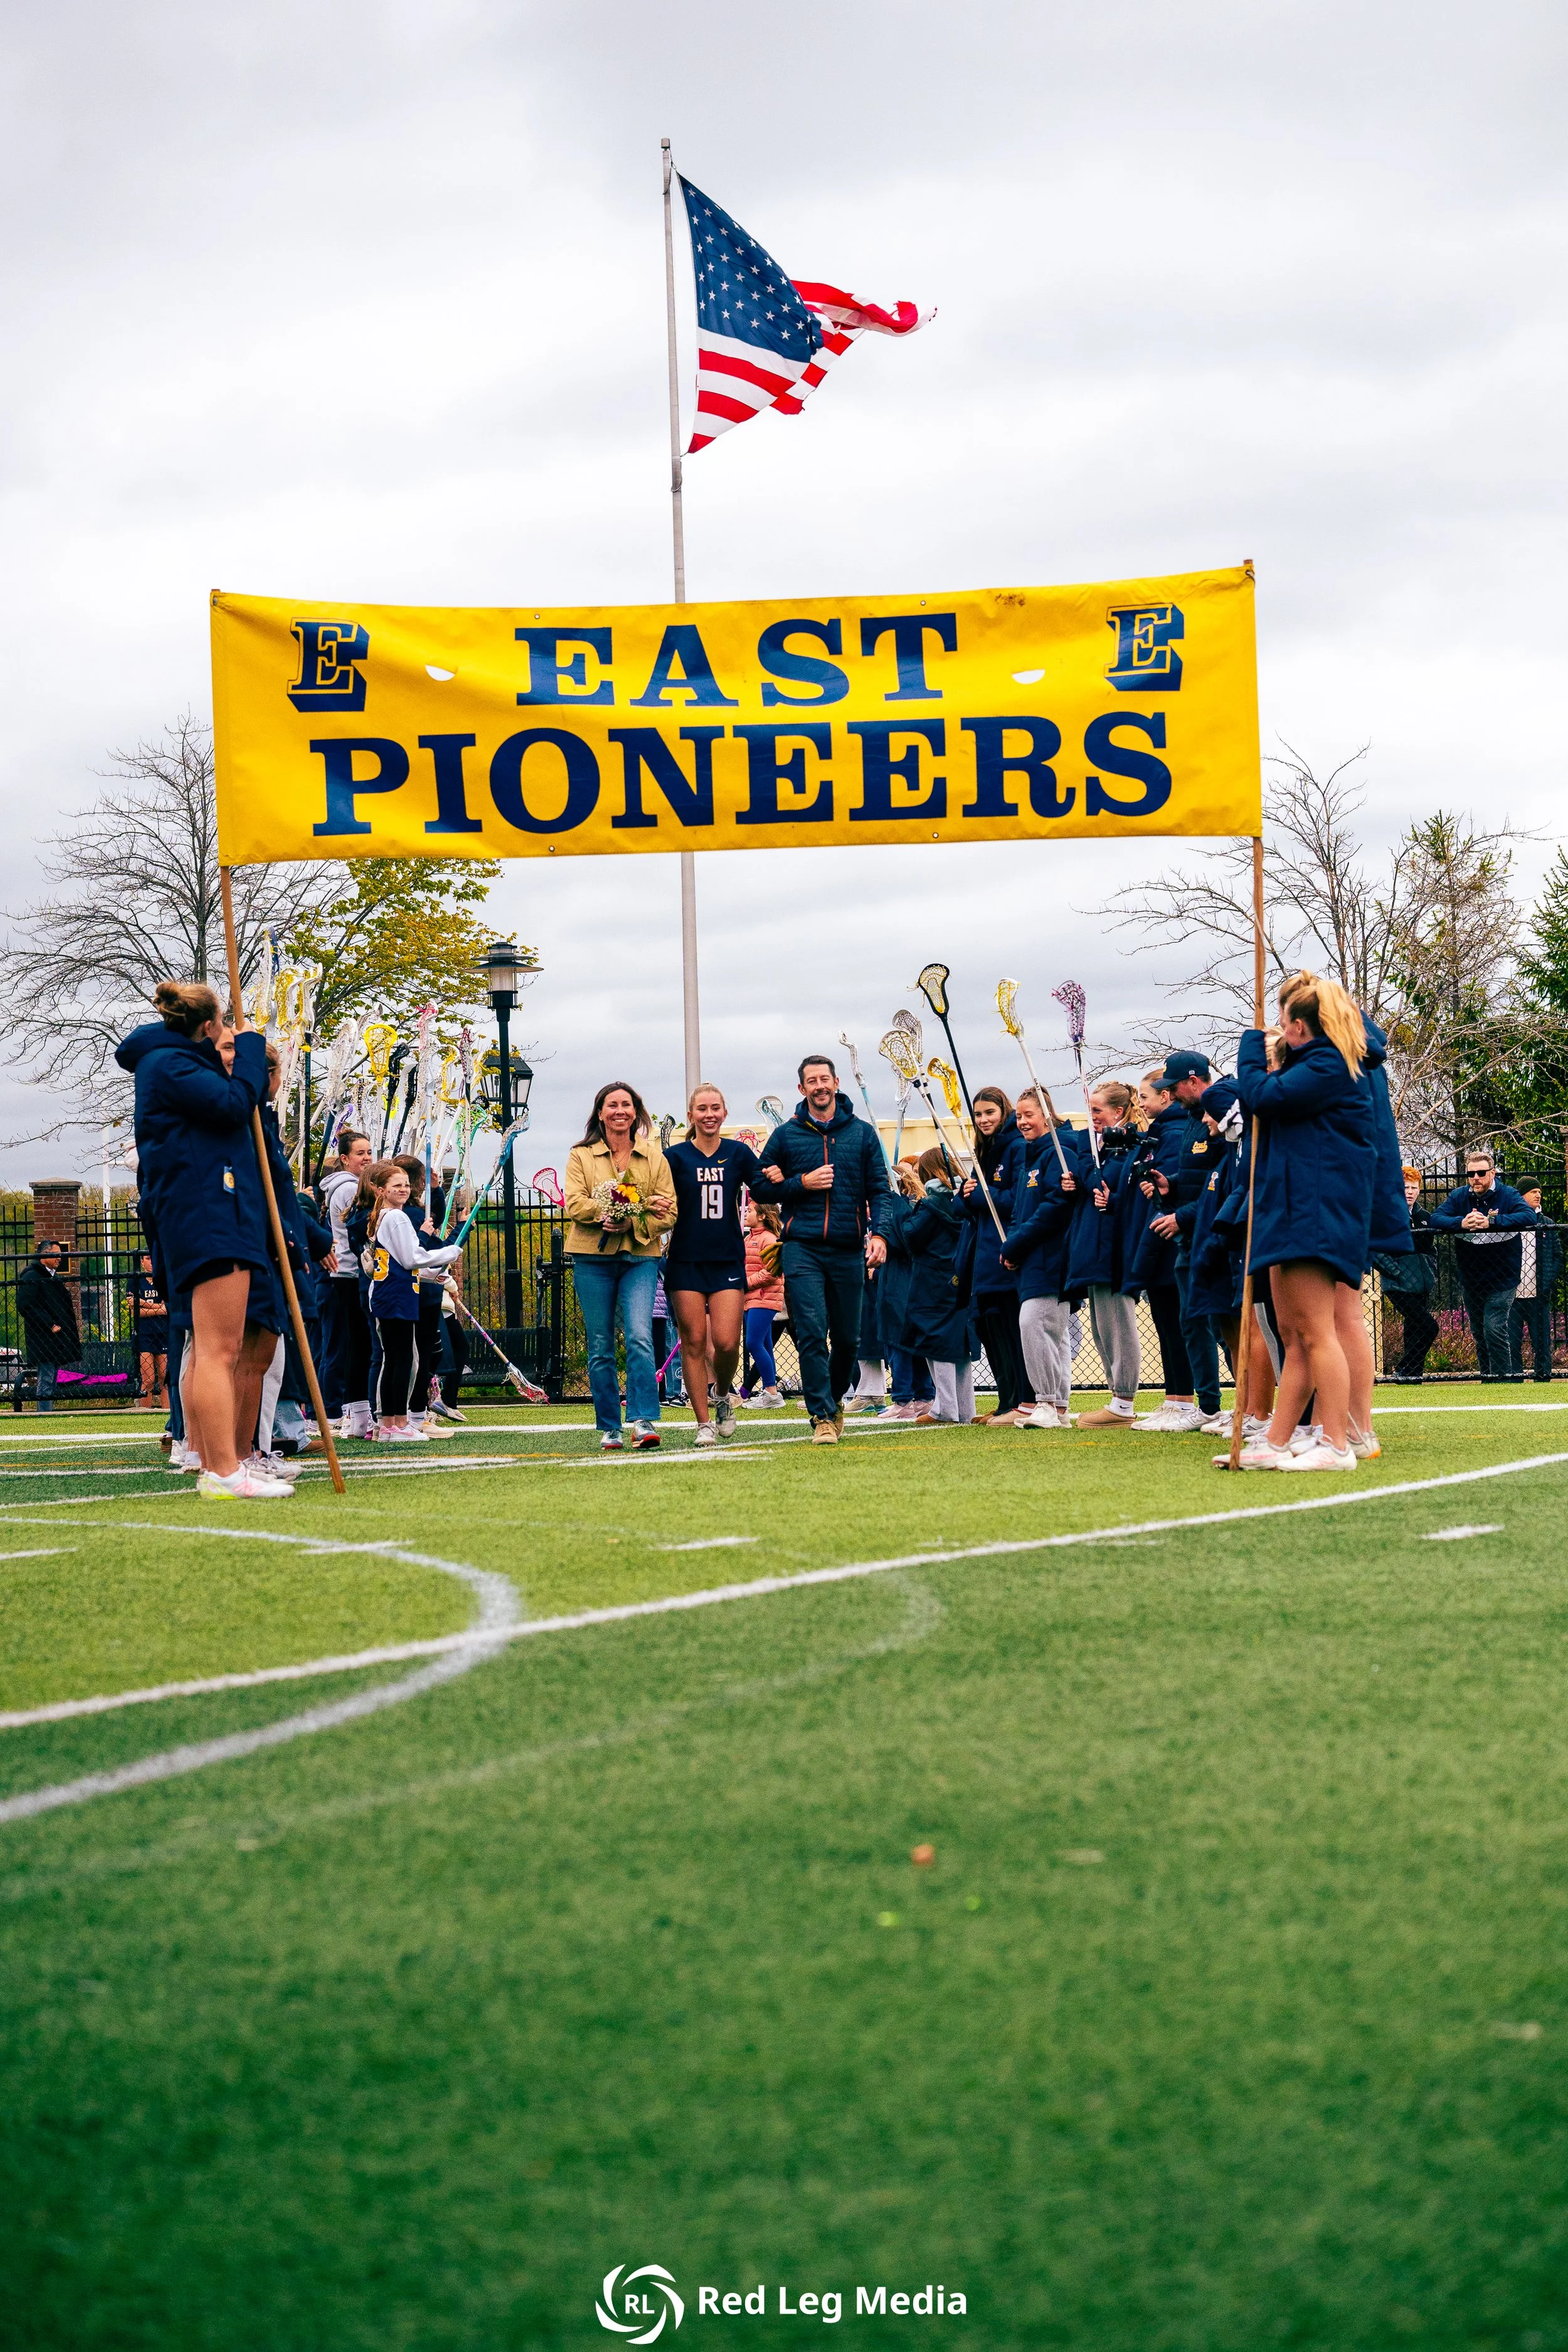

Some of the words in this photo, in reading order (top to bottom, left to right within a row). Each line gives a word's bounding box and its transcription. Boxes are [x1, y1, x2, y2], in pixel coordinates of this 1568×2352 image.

[287, 617, 369, 712] E
[516, 612, 957, 707] EAST
[1104, 603, 1184, 691] E
[310, 712, 1172, 836] PIONEERS
[697, 1167, 724, 1182] EAST
[701, 1184, 723, 1219] 19
